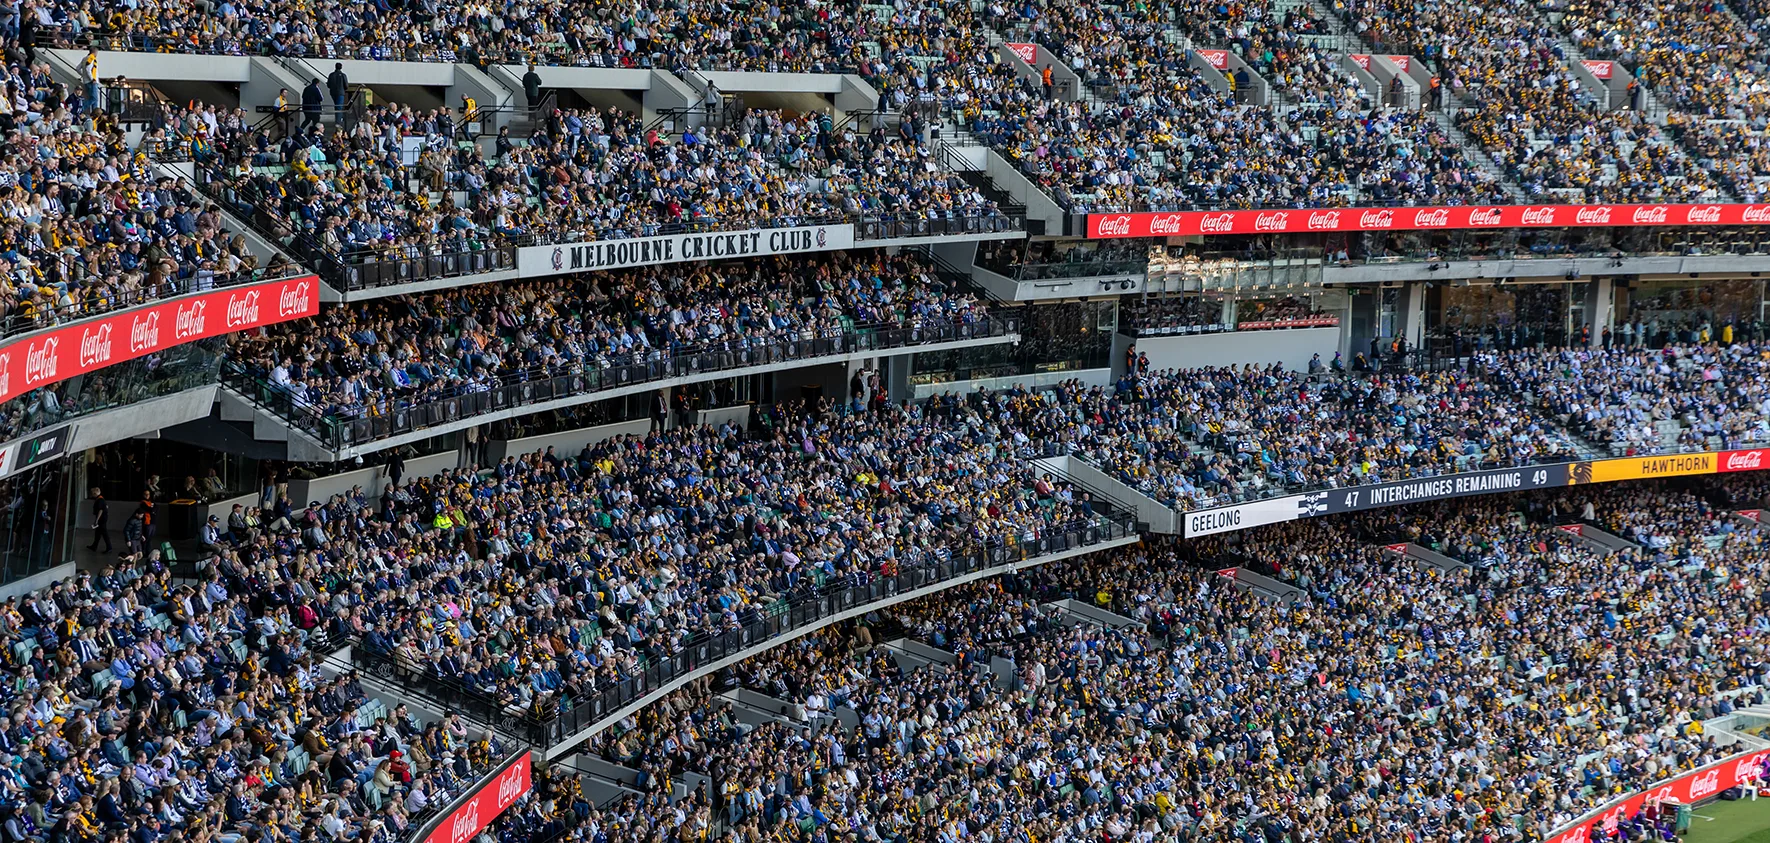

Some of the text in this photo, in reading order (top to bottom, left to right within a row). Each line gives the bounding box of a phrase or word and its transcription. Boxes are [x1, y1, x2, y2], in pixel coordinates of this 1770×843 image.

[570, 230, 812, 269] MELBOURNE CRICKET CLUB
[1642, 456, 1710, 474] HAWTHORN
[1345, 470, 1547, 507] 47 INTERCHANGES REMAINING 49
[1192, 510, 1241, 533] GEELONG
